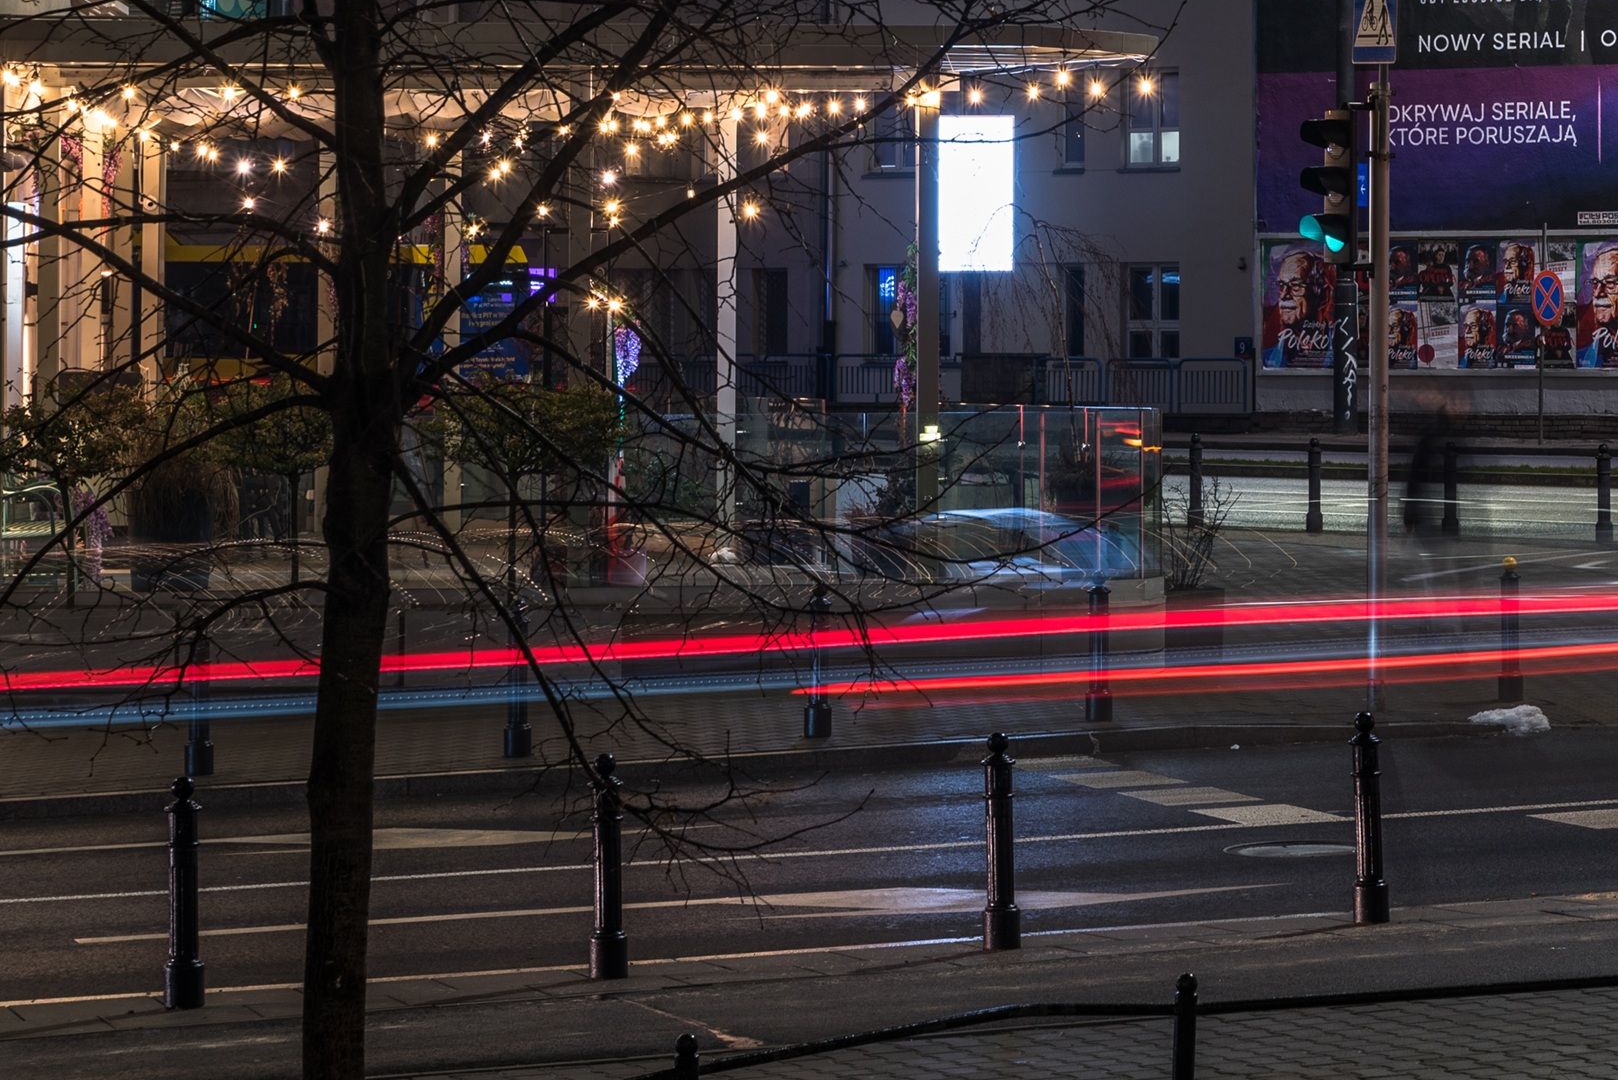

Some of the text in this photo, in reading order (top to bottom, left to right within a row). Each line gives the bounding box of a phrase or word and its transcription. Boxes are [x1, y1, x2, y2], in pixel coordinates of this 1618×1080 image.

[1418, 33, 1486, 53] NOWY
[1492, 30, 1566, 50] SERIAL
[1389, 101, 1577, 123] DKRYWAJ SERIALE,
[1456, 124, 1578, 147] PORUSZAJĄ
